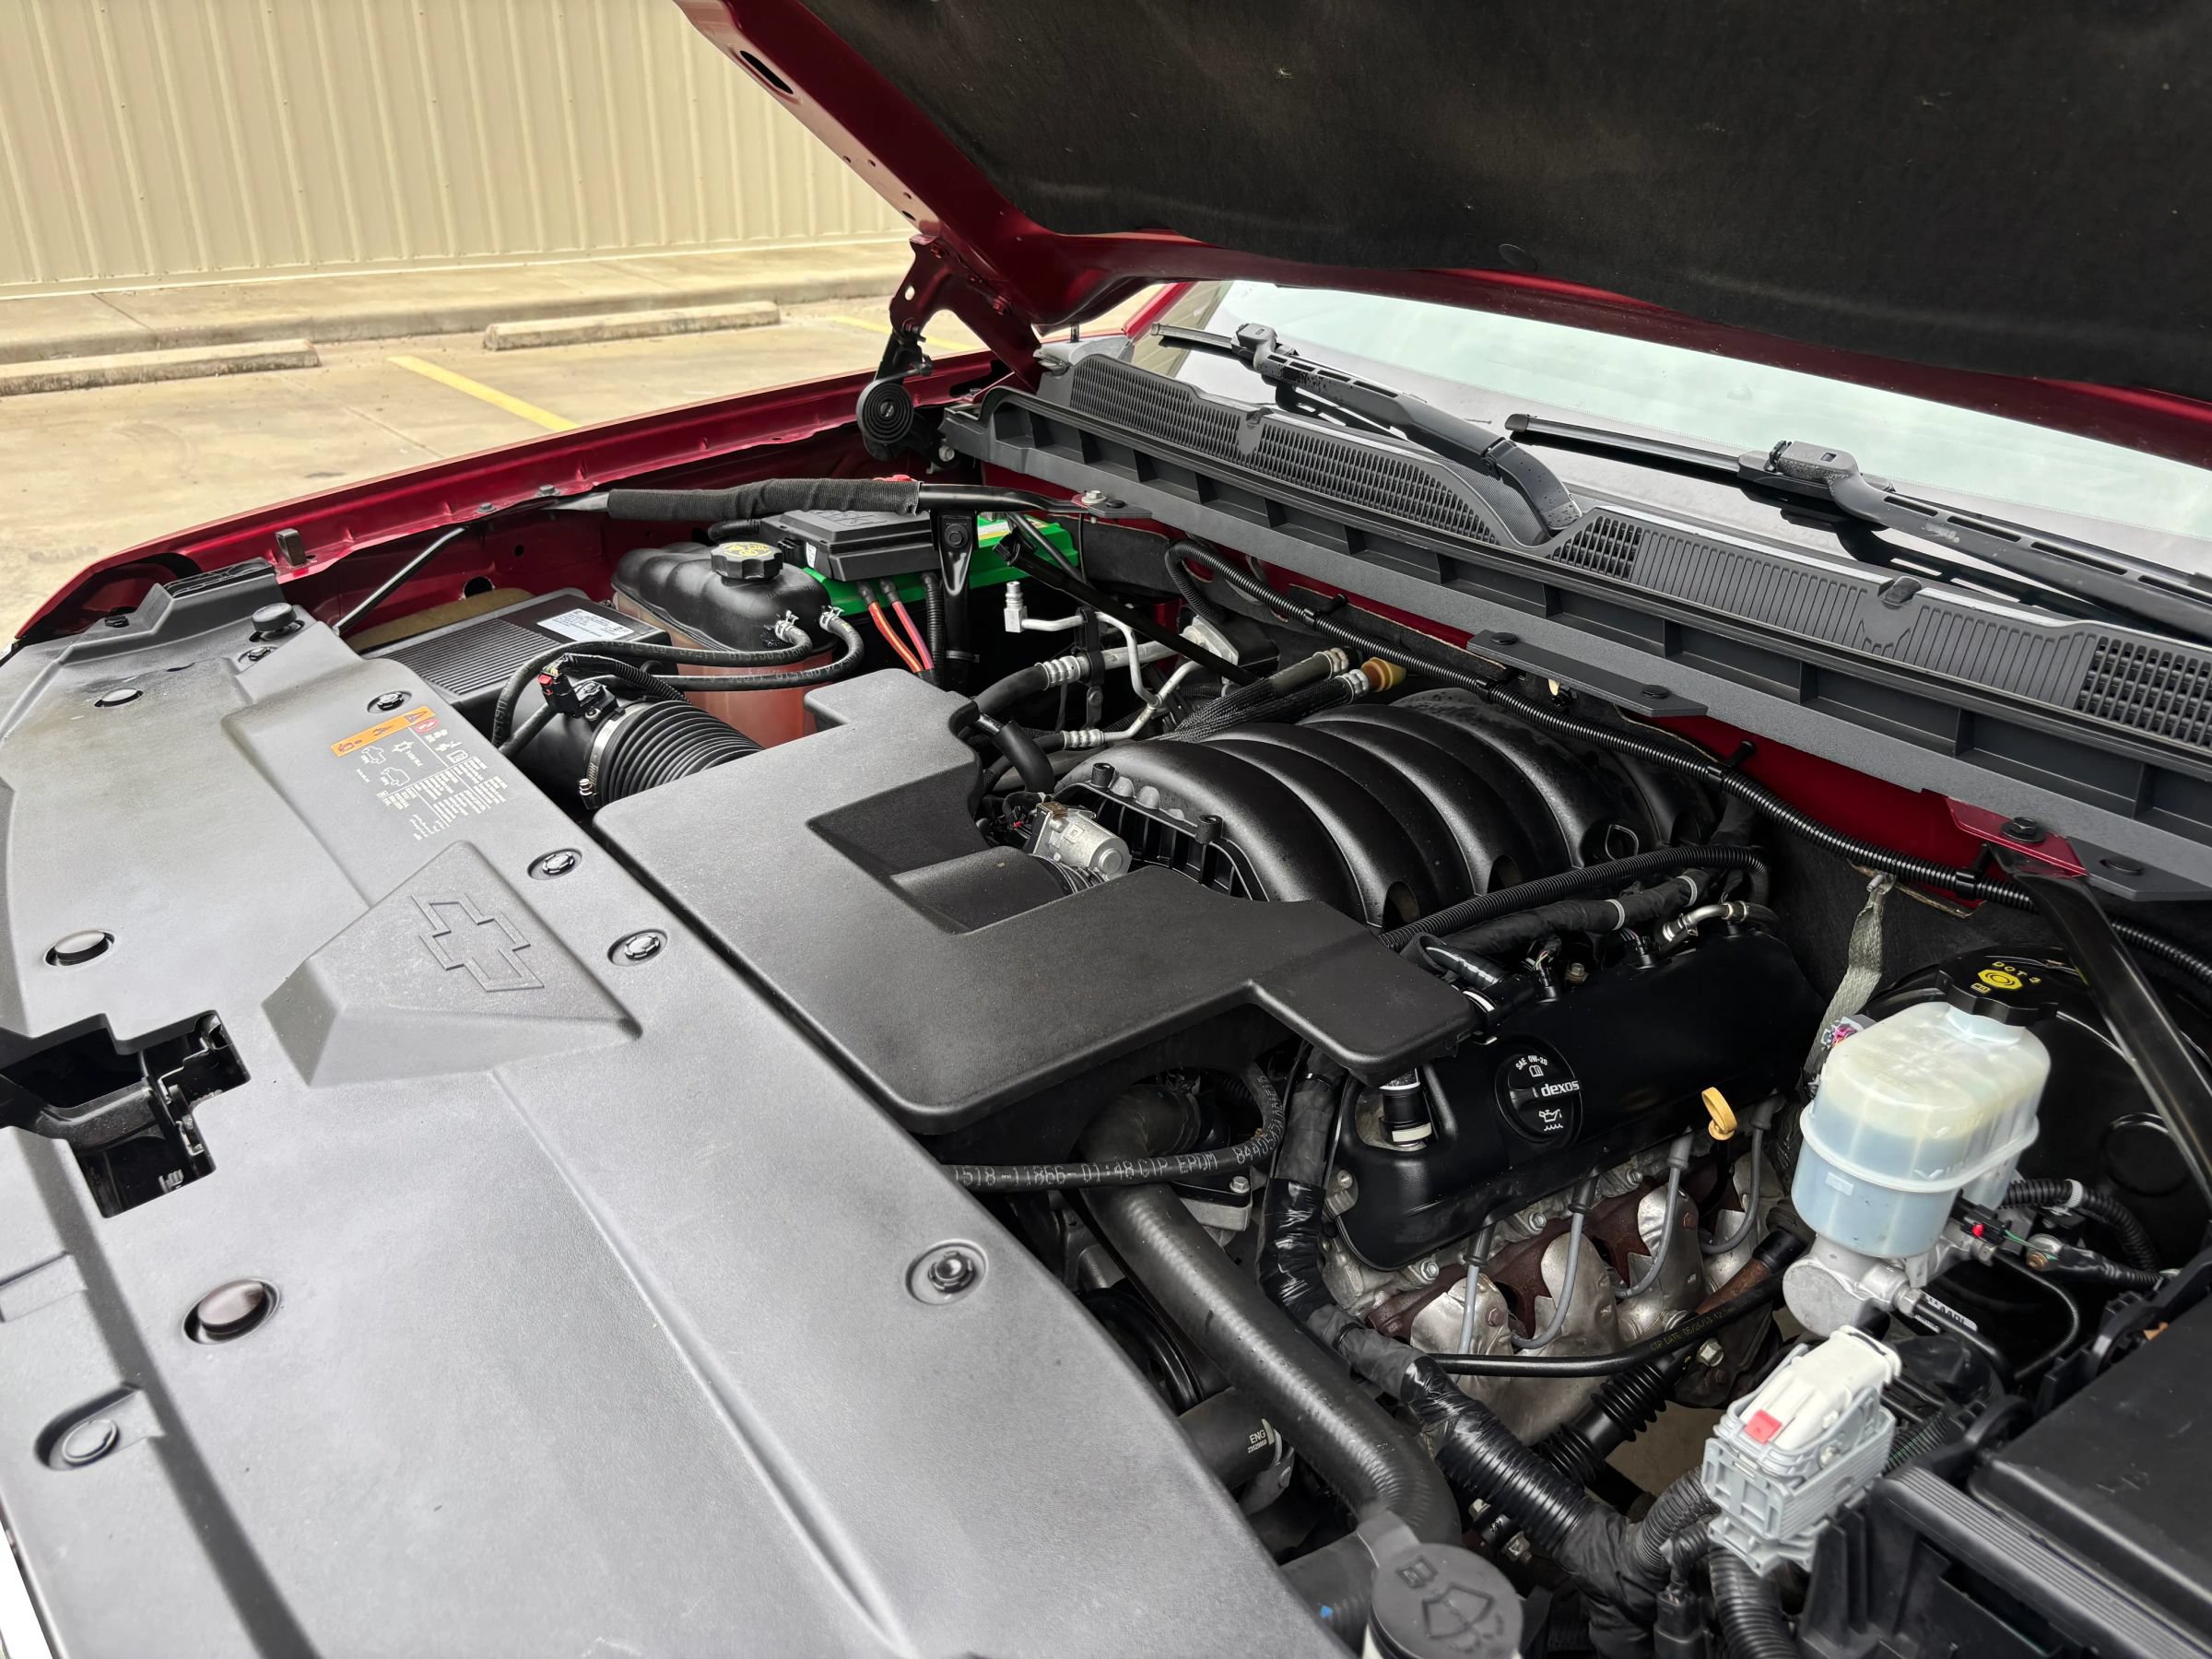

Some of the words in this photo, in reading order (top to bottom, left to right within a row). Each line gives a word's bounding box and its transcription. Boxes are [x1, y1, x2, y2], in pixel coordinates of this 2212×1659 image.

[1992, 961, 2027, 977] DOT
[1515, 1057, 1528, 1070] SAE
[1528, 1055, 1547, 1065] 0W-20
[1540, 1080, 1580, 1097] dexos
[1249, 1430, 1266, 1444] ENG
